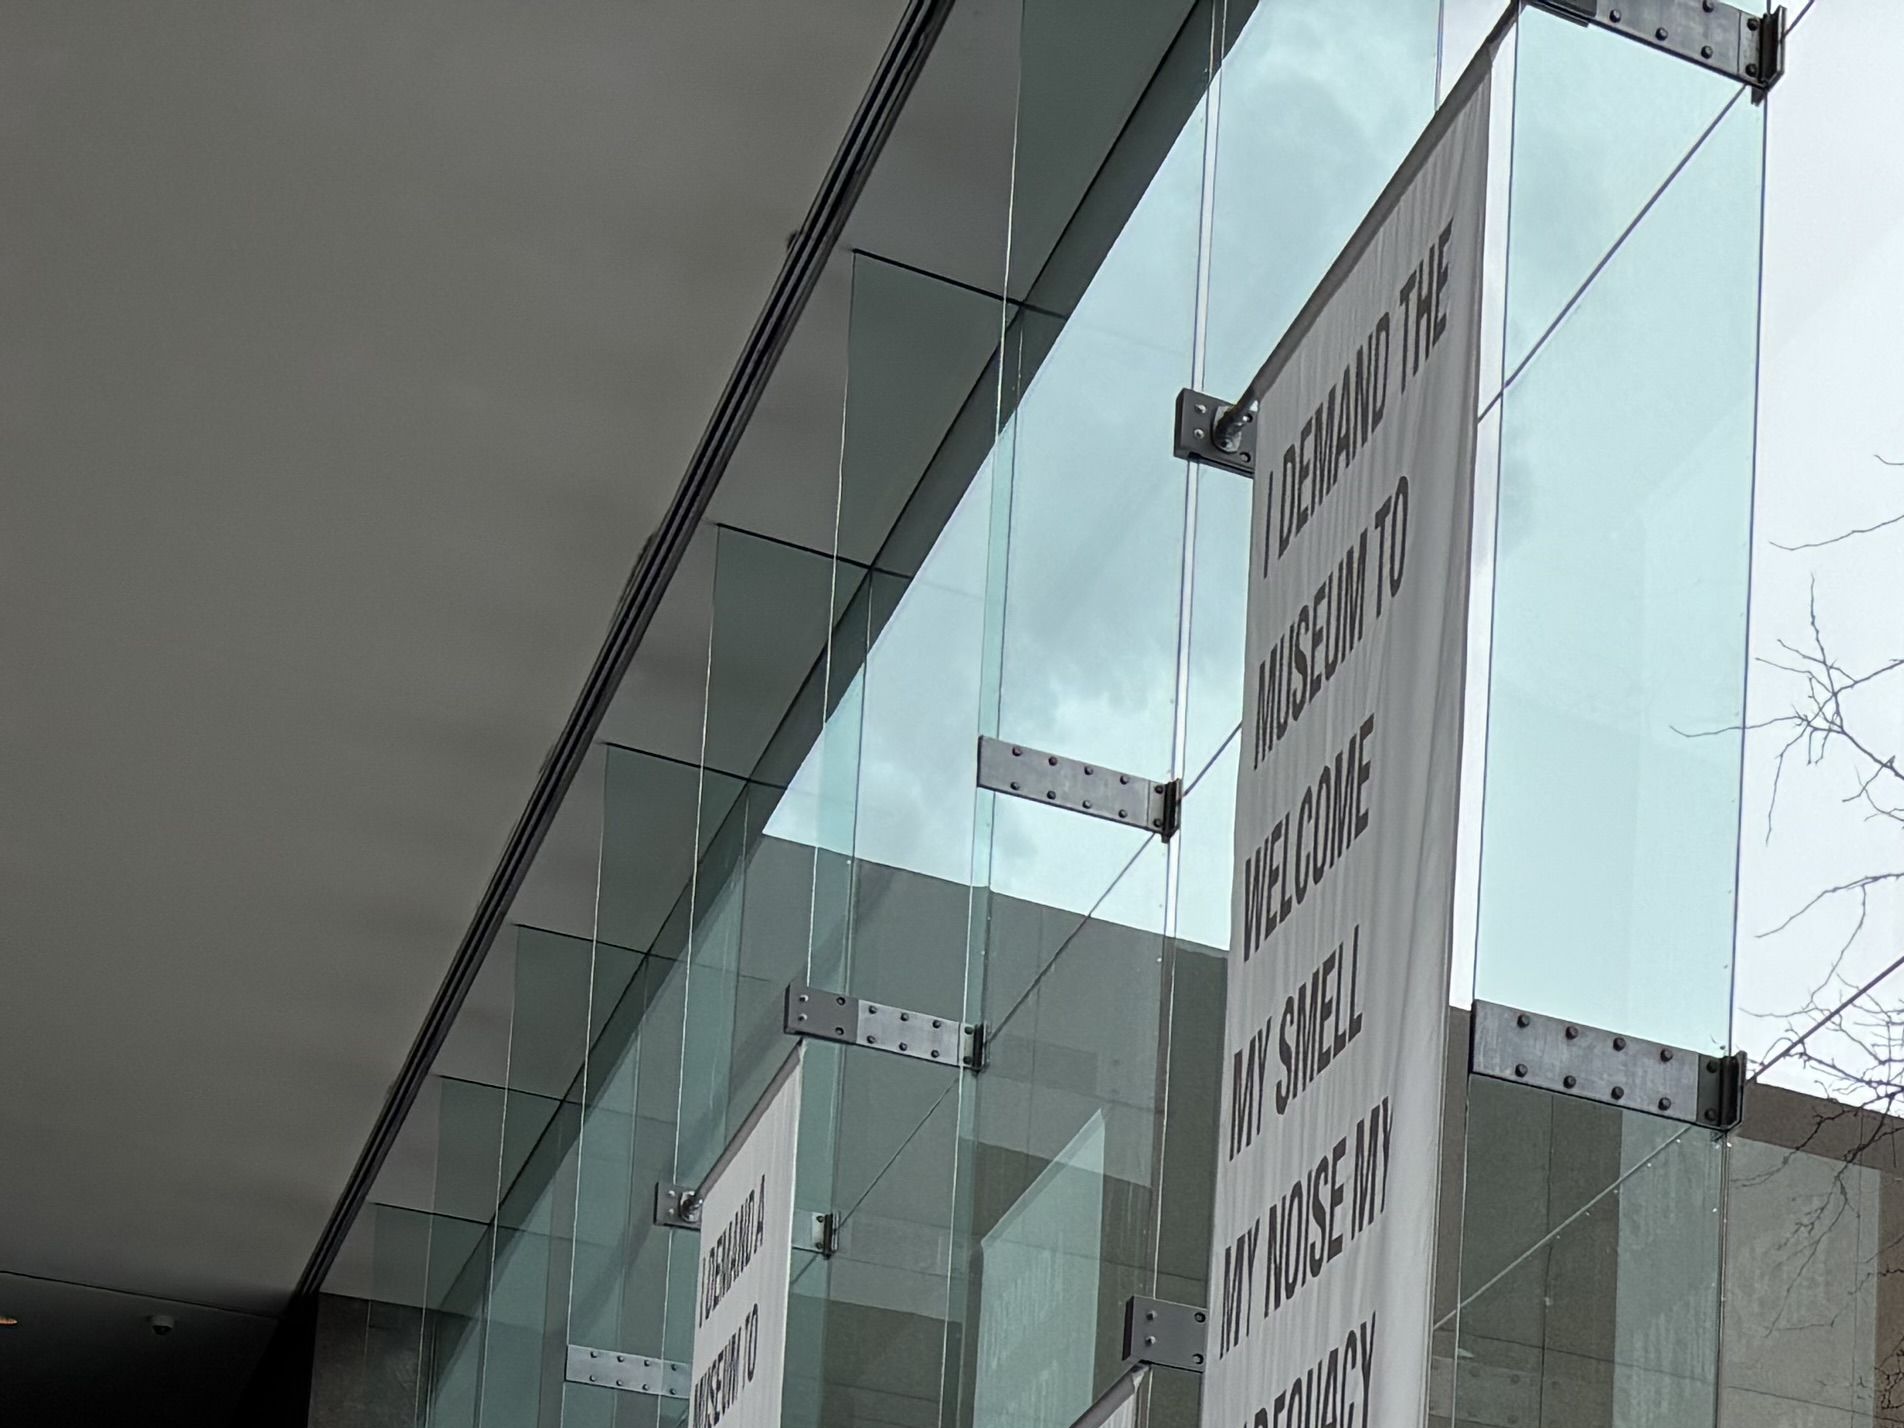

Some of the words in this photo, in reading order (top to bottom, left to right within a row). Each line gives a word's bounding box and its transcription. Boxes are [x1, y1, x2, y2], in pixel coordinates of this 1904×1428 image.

[1262, 470, 1274, 579] I
[1278, 312, 1390, 558] DEMAND
[1398, 220, 1455, 394] THE
[1252, 540, 1368, 772] MUSEUM
[1373, 474, 1412, 623] TO
[1242, 712, 1376, 963] WELCOME
[1228, 1018, 1274, 1165] MY
[1274, 924, 1364, 1115] SMELL
[1217, 1217, 1262, 1362] MY
[1264, 1156, 1346, 1318] NOISE
[1350, 1096, 1394, 1243] MY
